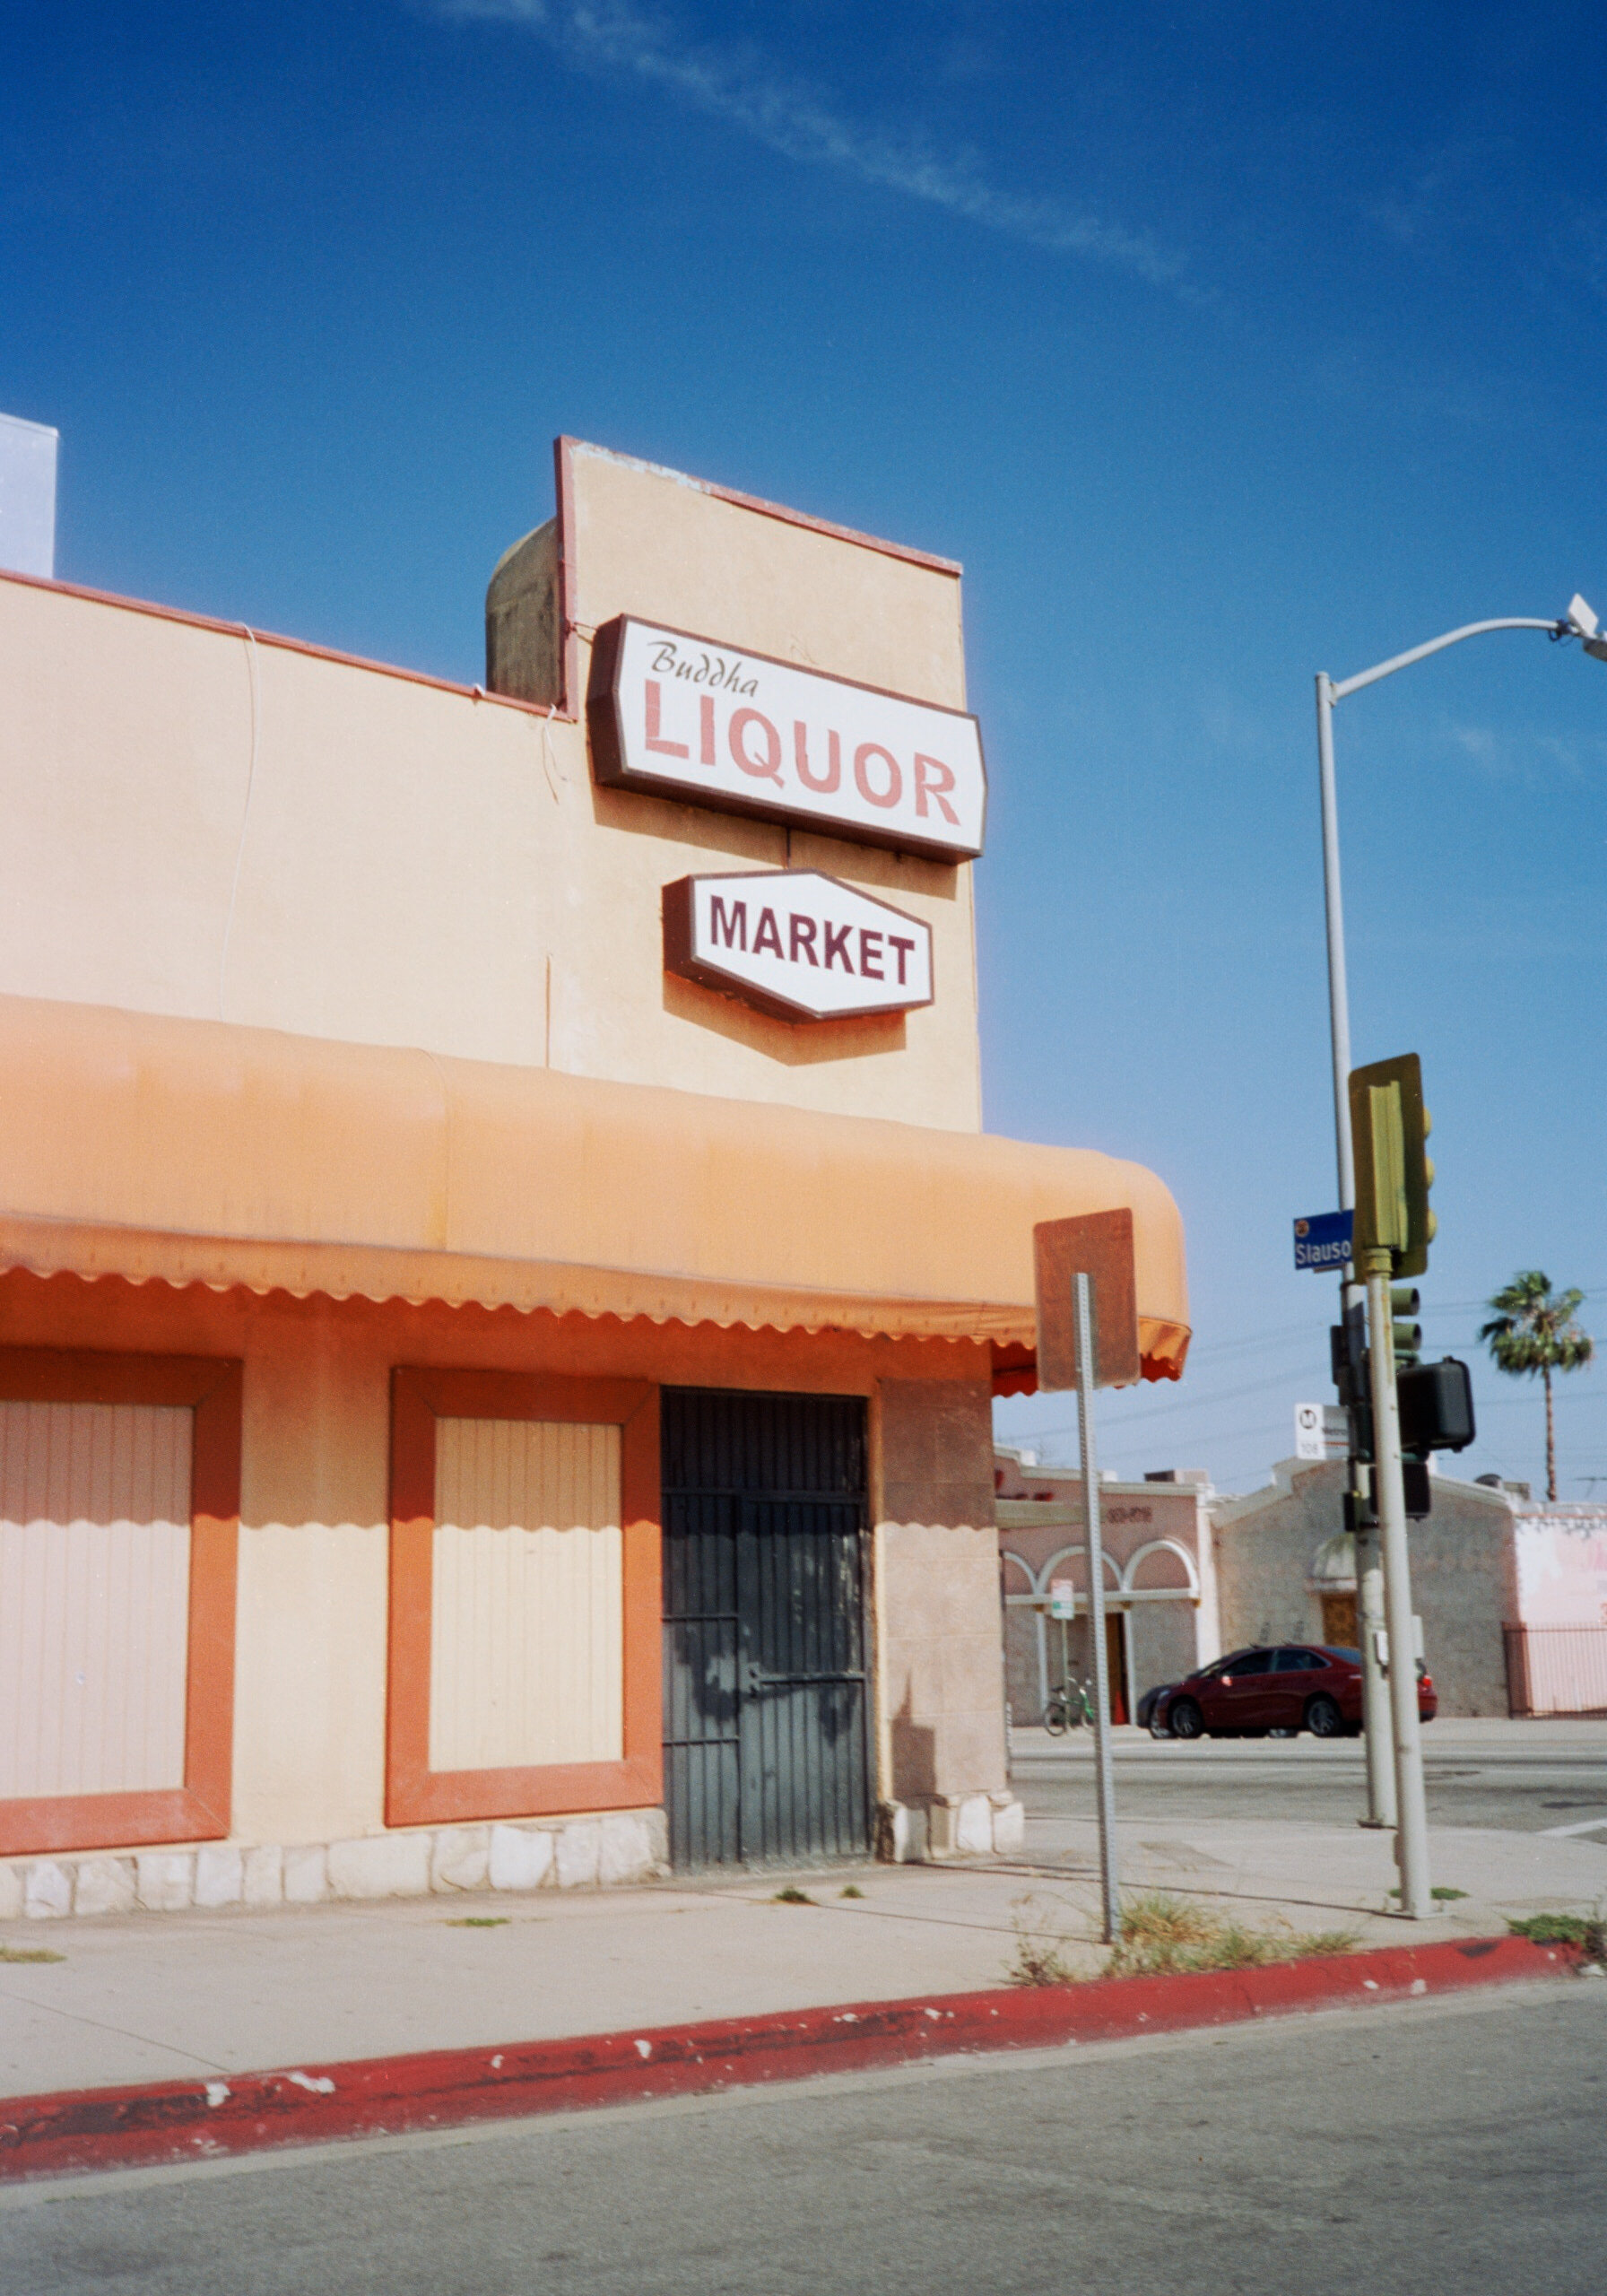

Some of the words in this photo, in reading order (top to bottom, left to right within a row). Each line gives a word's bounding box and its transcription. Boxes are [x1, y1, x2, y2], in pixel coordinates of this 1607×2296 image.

[647, 640, 760, 698] Buddha
[645, 678, 961, 827] LIQUOR
[710, 894, 916, 986] MARKET
[1296, 1239, 1352, 1265] Slauso
